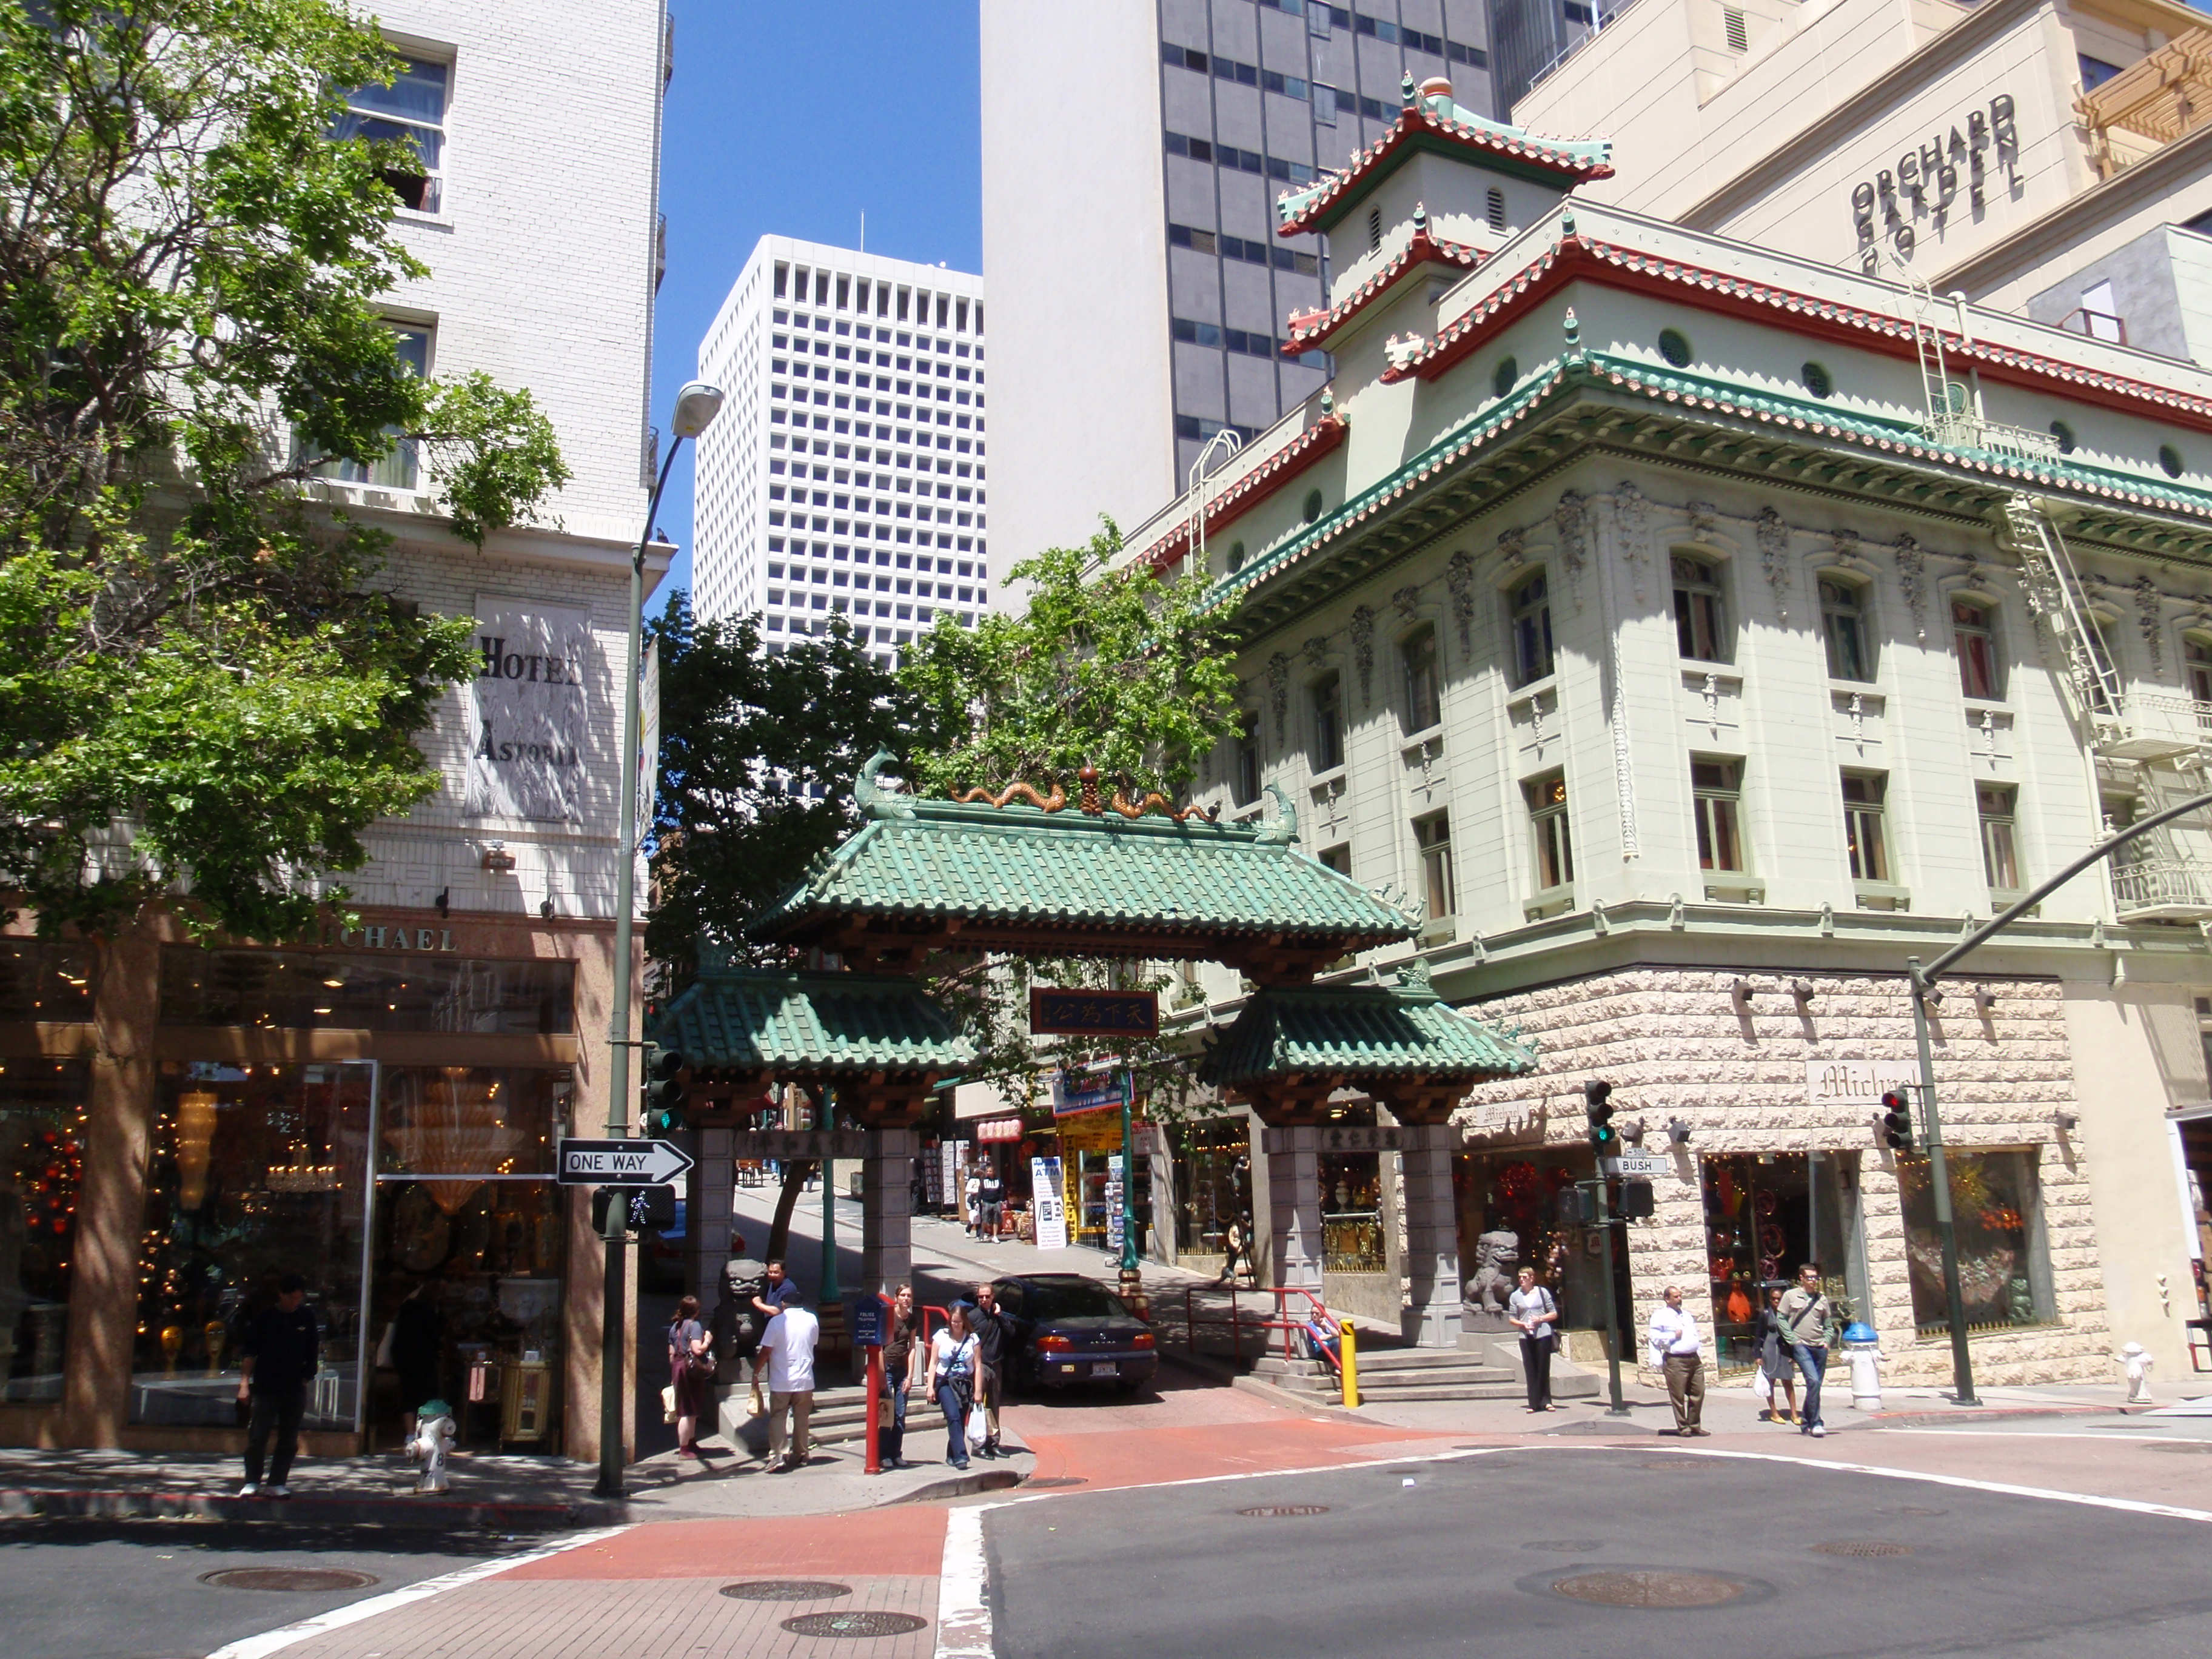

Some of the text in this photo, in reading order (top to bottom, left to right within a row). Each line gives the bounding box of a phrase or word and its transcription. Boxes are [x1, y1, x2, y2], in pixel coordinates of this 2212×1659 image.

[1851, 93, 2015, 210] ORCHARD
[1856, 124, 2019, 239] GARDEN
[1860, 163, 2024, 275] HOTEL
[295, 923, 458, 953] ICHAEL
[570, 1155, 647, 1170] ONE WAY
[1035, 1168, 1059, 1176] ATM
[1623, 1161, 1652, 1171] BUSH
[436, 1452, 444, 1467] 8
